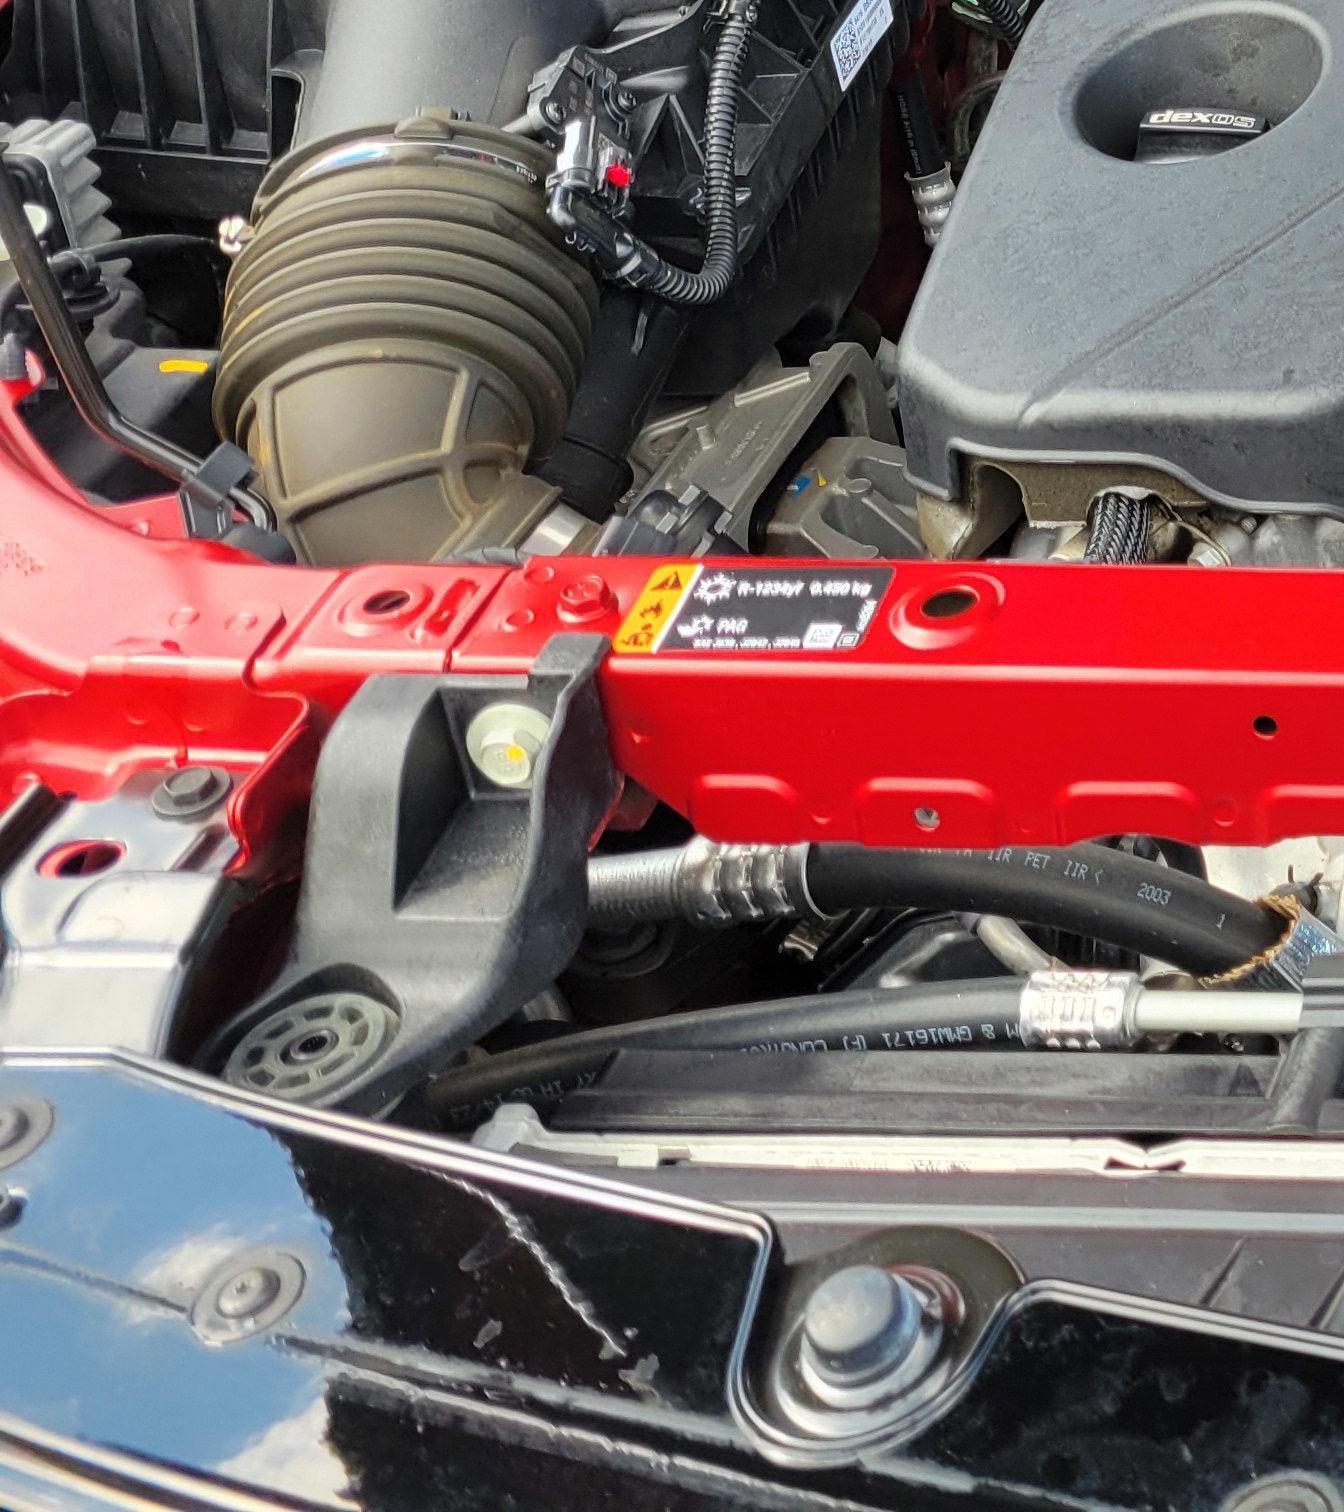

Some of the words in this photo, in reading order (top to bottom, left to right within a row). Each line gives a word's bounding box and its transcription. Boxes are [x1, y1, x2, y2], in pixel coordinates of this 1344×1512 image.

[1149, 110, 1256, 128] dexos
[809, 580, 850, 598] 0.450
[852, 580, 872, 599] kg
[717, 617, 748, 634] PAG
[1024, 851, 1050, 870] PET
[1137, 882, 1171, 905] 2003
[882, 1024, 972, 1048] GMW16171
